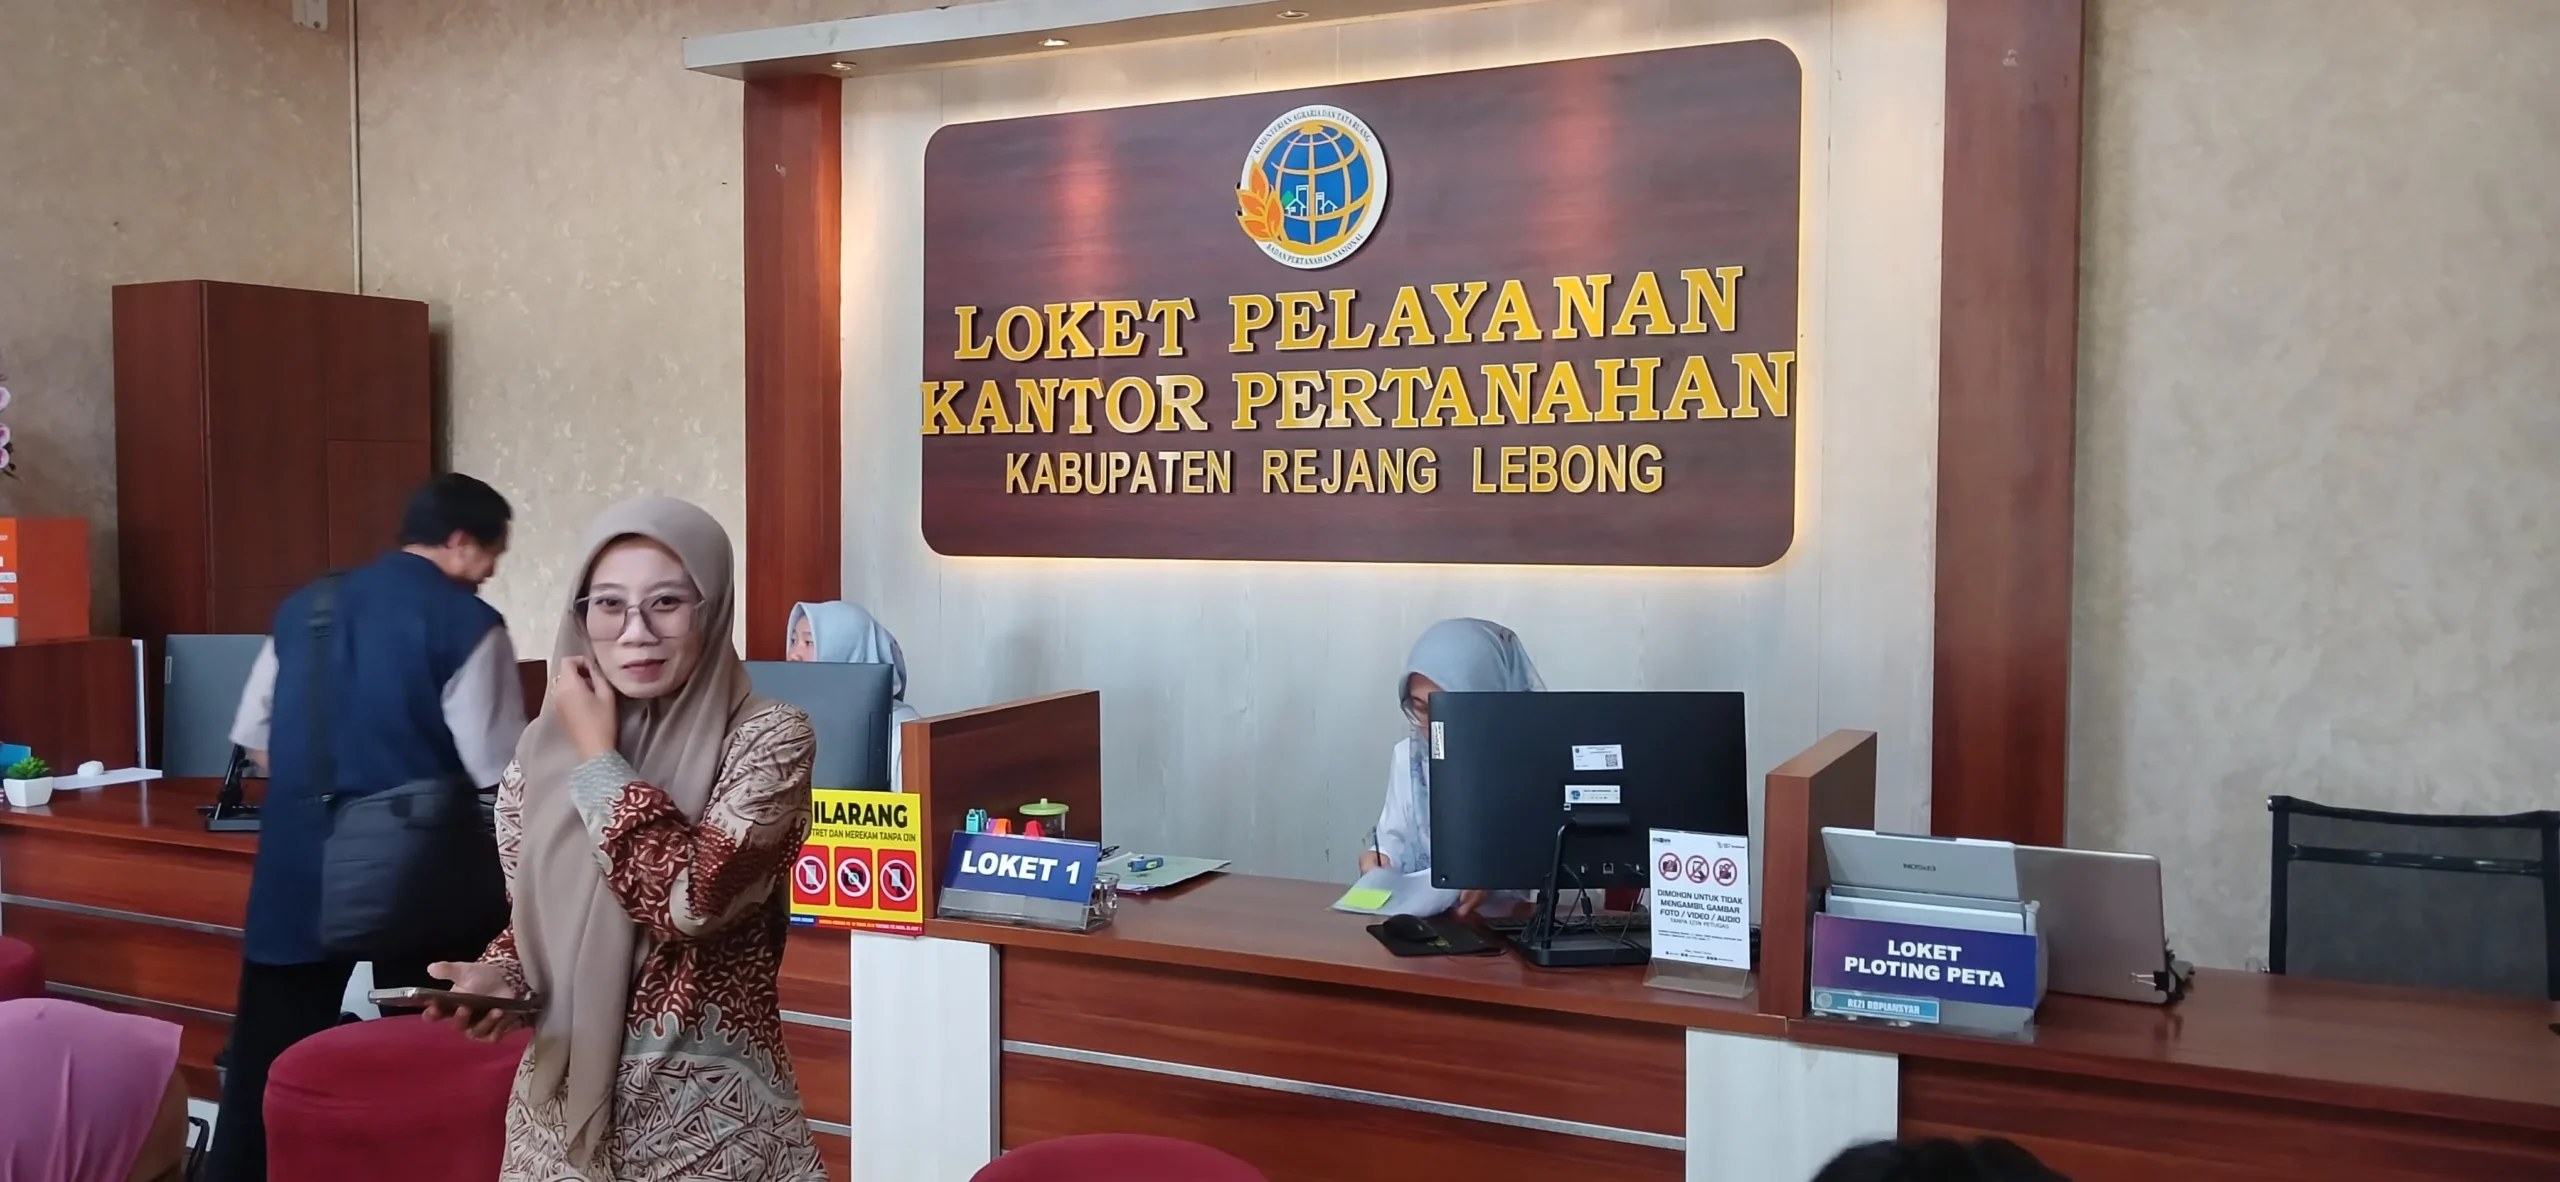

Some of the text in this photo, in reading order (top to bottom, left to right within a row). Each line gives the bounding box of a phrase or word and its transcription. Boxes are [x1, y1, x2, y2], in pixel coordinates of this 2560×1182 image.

[1322, 110, 1336, 118] DAN
[1336, 111, 1352, 125] TATA
[1351, 122, 1371, 142] RUANG
[955, 266, 1743, 361] LOKET PELAYANAN
[920, 351, 1794, 435] KANTOR PERTANAHAN
[1006, 444, 1663, 494] KABUPATEN REJANG LEBONG
[814, 801, 908, 828] ILARANG
[811, 828, 828, 837] TRET
[829, 829, 844, 839] DAN
[845, 830, 878, 840] MEREKAM
[879, 831, 902, 841] TANPA
[960, 850, 1080, 884] LOKET 1
[1657, 889, 1743, 904] DIMOHON UNTUK TIDAK
[1660, 899, 1740, 914] MENGAMBIL GAMBAR
[1660, 909, 1680, 917] FOTO
[1687, 912, 1710, 921] VIDEO
[1717, 915, 1741, 923] AUDIO
[1888, 940, 1962, 961] LOKET
[1844, 956, 2005, 988] PLOTING PETA
